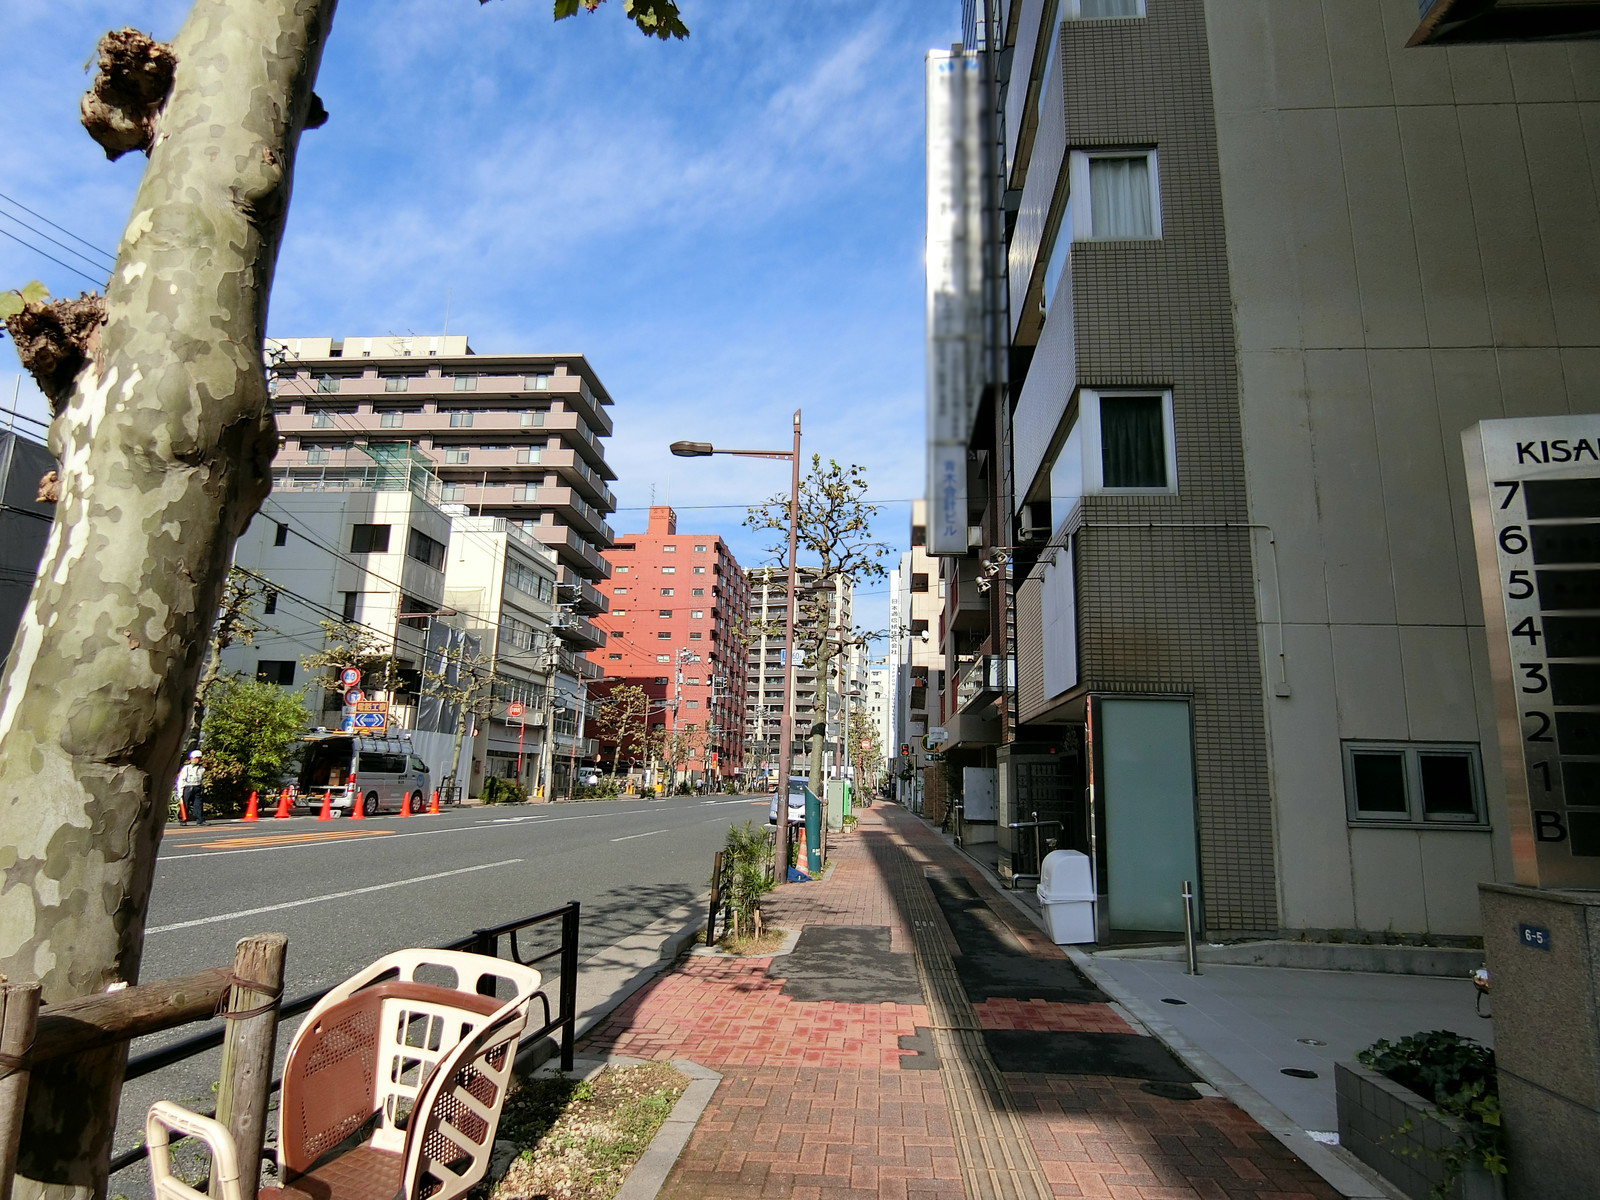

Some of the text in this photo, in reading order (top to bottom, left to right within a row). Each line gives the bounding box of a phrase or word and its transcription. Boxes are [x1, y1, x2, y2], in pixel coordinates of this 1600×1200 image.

[1516, 438, 1600, 464] KISA
[1494, 481, 1521, 510] 7
[1499, 525, 1528, 555] 6
[1508, 569, 1535, 600] 5
[1511, 616, 1542, 646] 4
[1520, 662, 1548, 694] 3
[1525, 711, 1554, 742] 2
[1532, 760, 1552, 792] 1
[1534, 810, 1568, 843] B
[1524, 929, 1544, 944] 6-5
